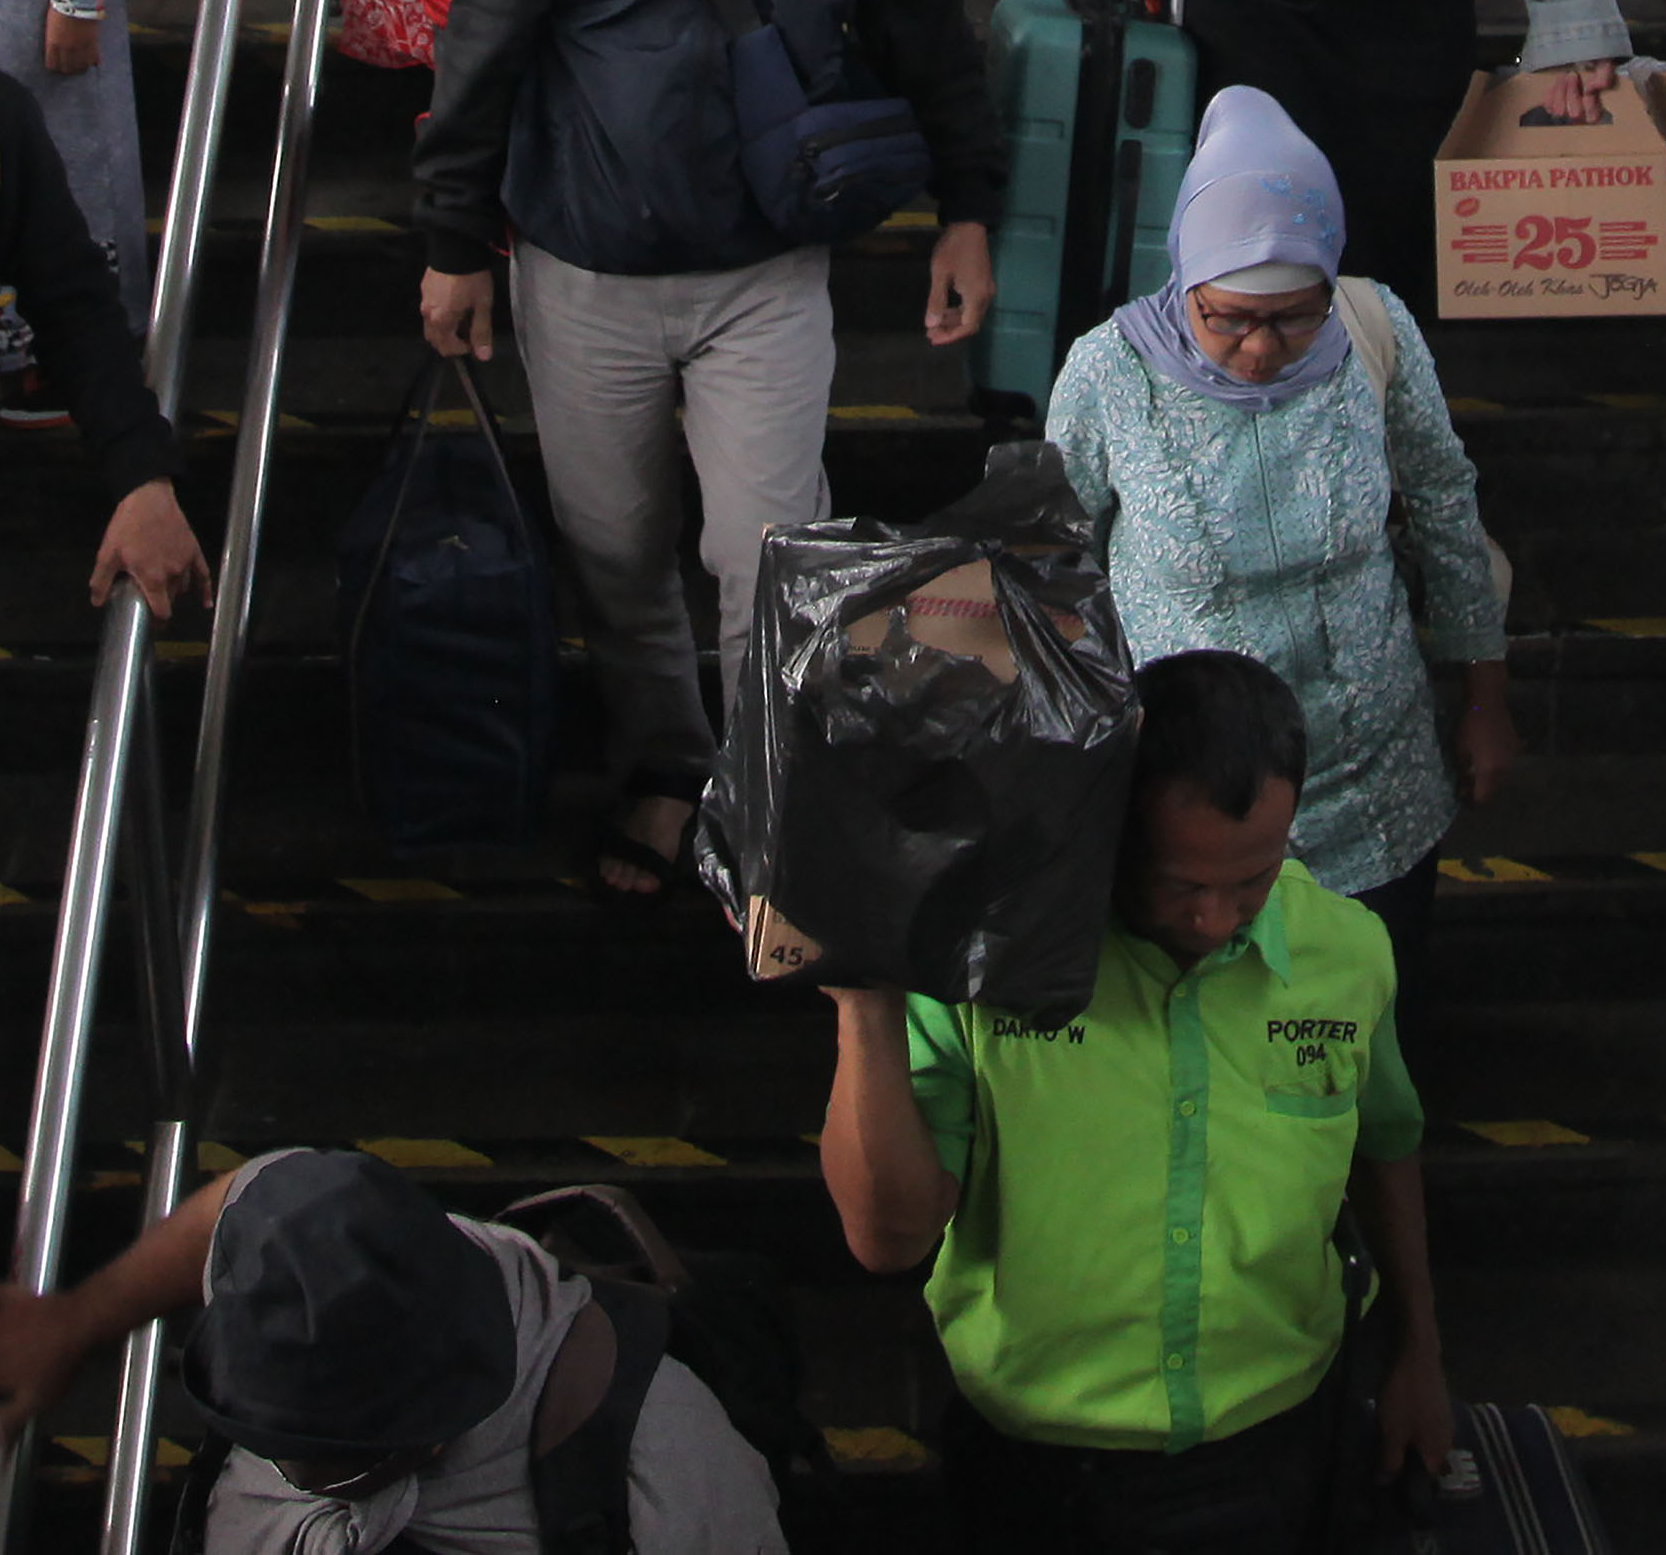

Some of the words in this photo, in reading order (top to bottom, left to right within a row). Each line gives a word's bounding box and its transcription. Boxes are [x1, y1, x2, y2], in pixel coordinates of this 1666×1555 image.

[1449, 168, 1544, 192] BAKPIA
[1549, 165, 1654, 189] PATHOK
[1512, 214, 1597, 271] 25
[769, 945, 804, 966] 45
[1067, 1025, 1085, 1045] W
[1266, 1019, 1358, 1044] PORTER
[1295, 1042, 1327, 1067] 094
